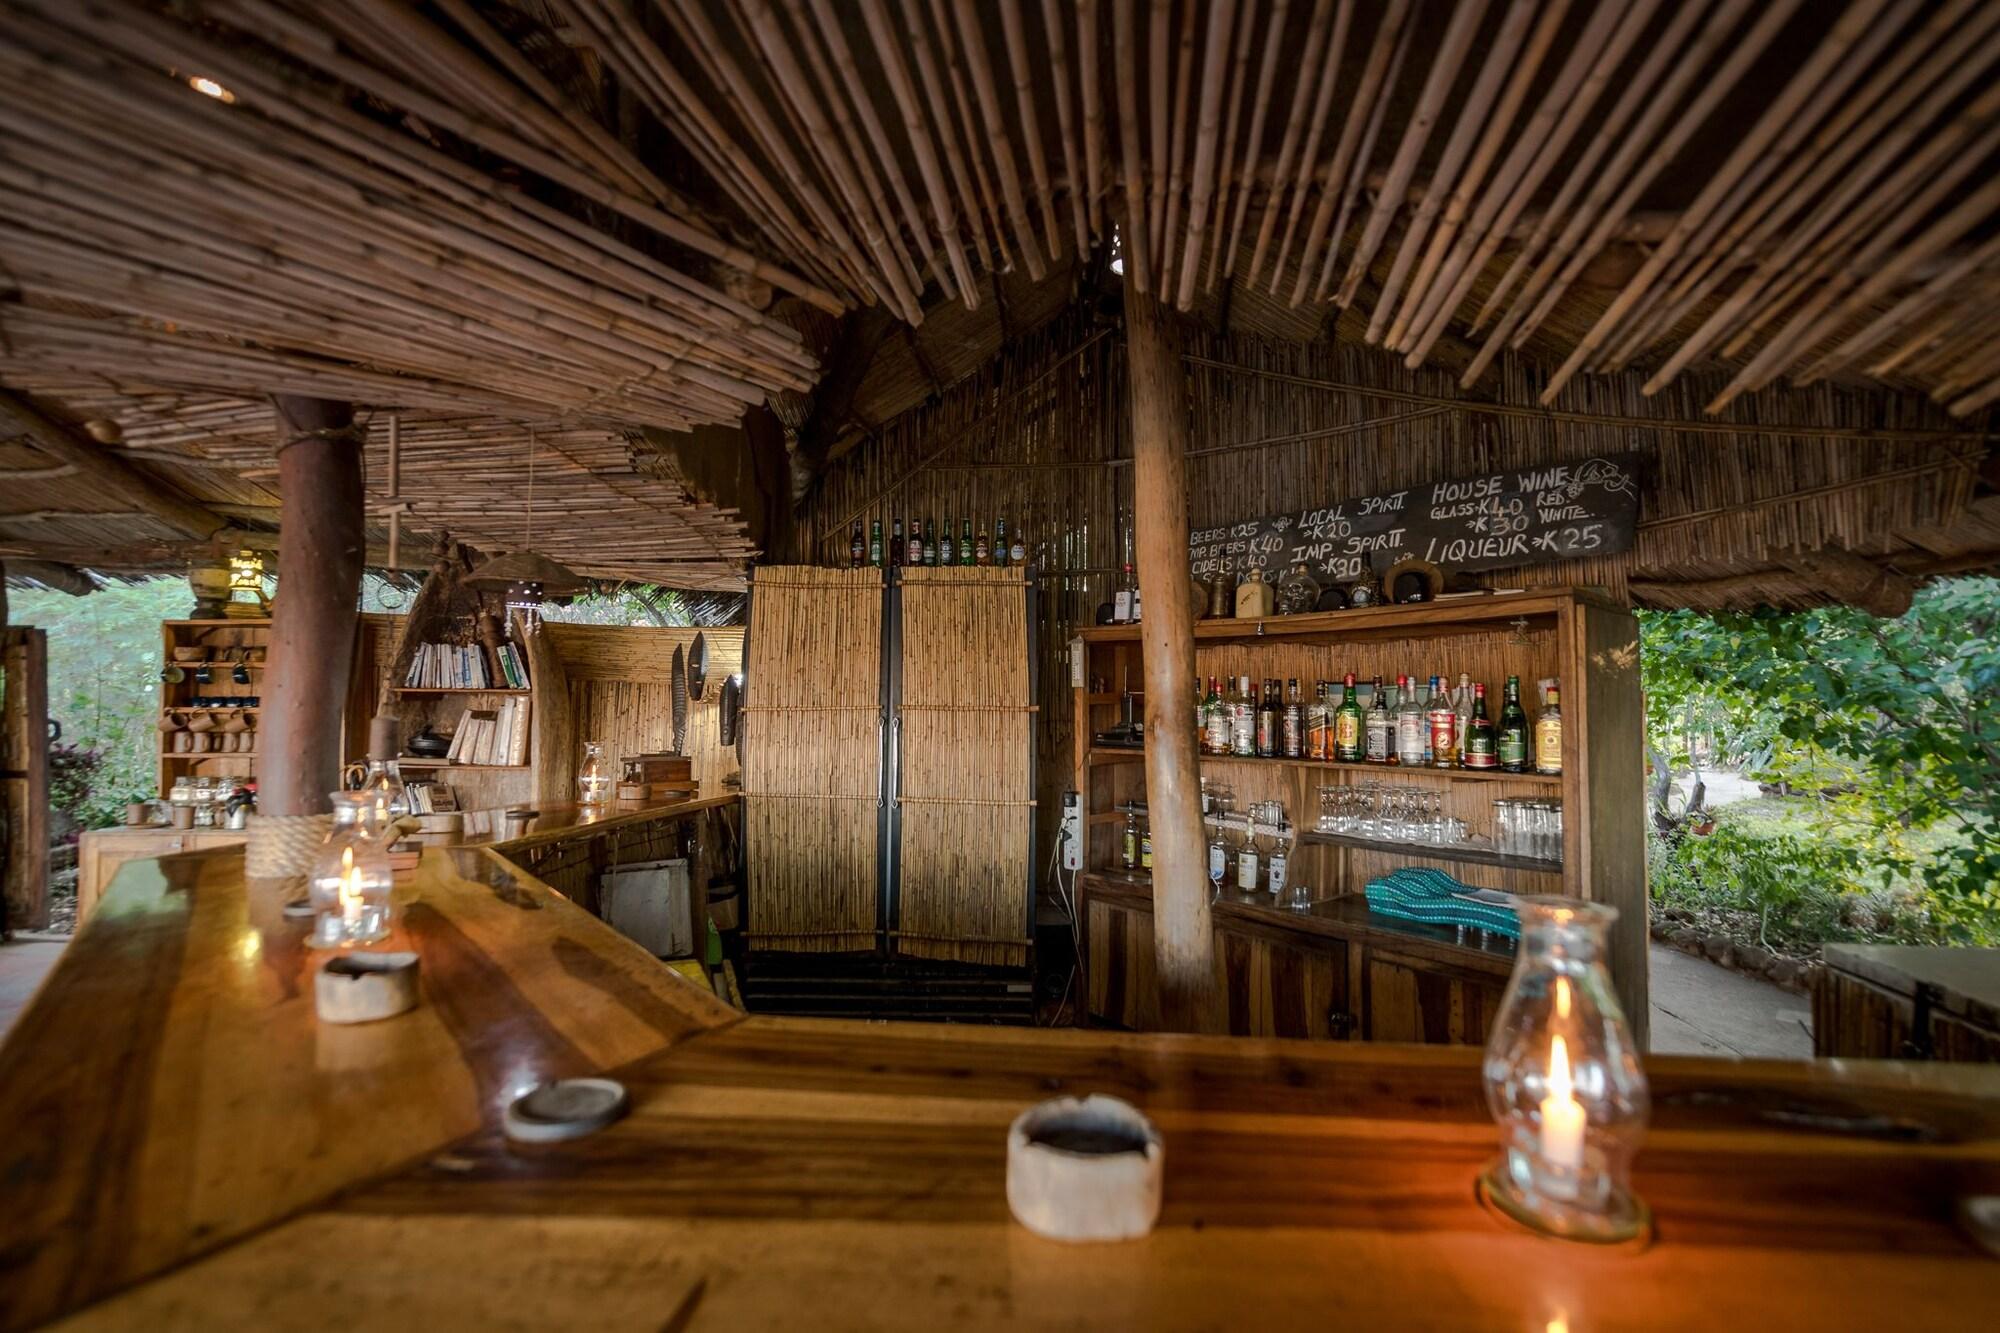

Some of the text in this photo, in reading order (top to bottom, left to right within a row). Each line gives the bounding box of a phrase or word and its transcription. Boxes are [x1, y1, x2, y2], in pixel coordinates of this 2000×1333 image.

[1431, 466, 1569, 505] HOUSE WINE
[1298, 505, 1346, 528] LOCAL
[1190, 521, 1260, 545] BEERS K25
[1249, 535, 1284, 554] K40
[1290, 542, 1335, 563] IMP.
[1424, 534, 1530, 564] LIQUEUR
[1236, 554, 1268, 571] K40
